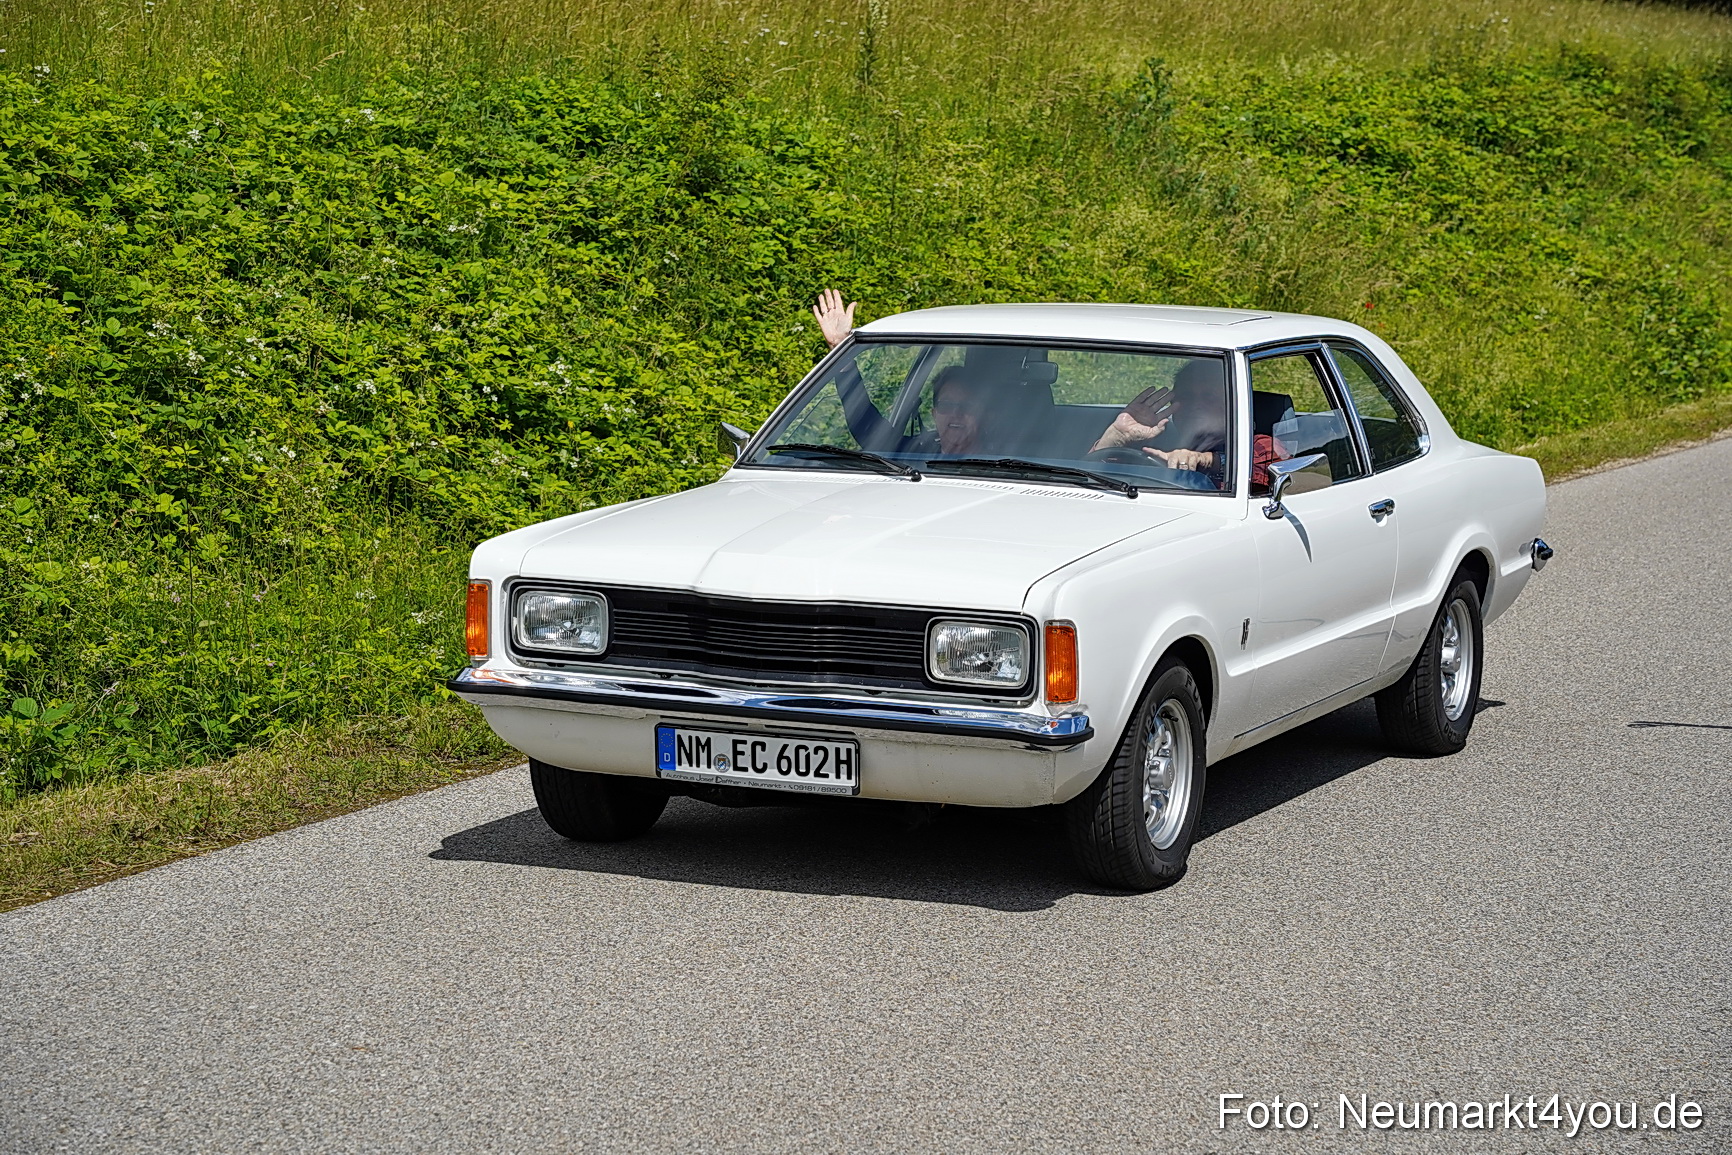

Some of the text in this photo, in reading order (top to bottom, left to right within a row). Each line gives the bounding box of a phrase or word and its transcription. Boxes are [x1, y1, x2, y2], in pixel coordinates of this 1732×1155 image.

[663, 752, 671, 762] D
[676, 733, 853, 781] NM EC 602H
[748, 780, 782, 789] Neumarkt
